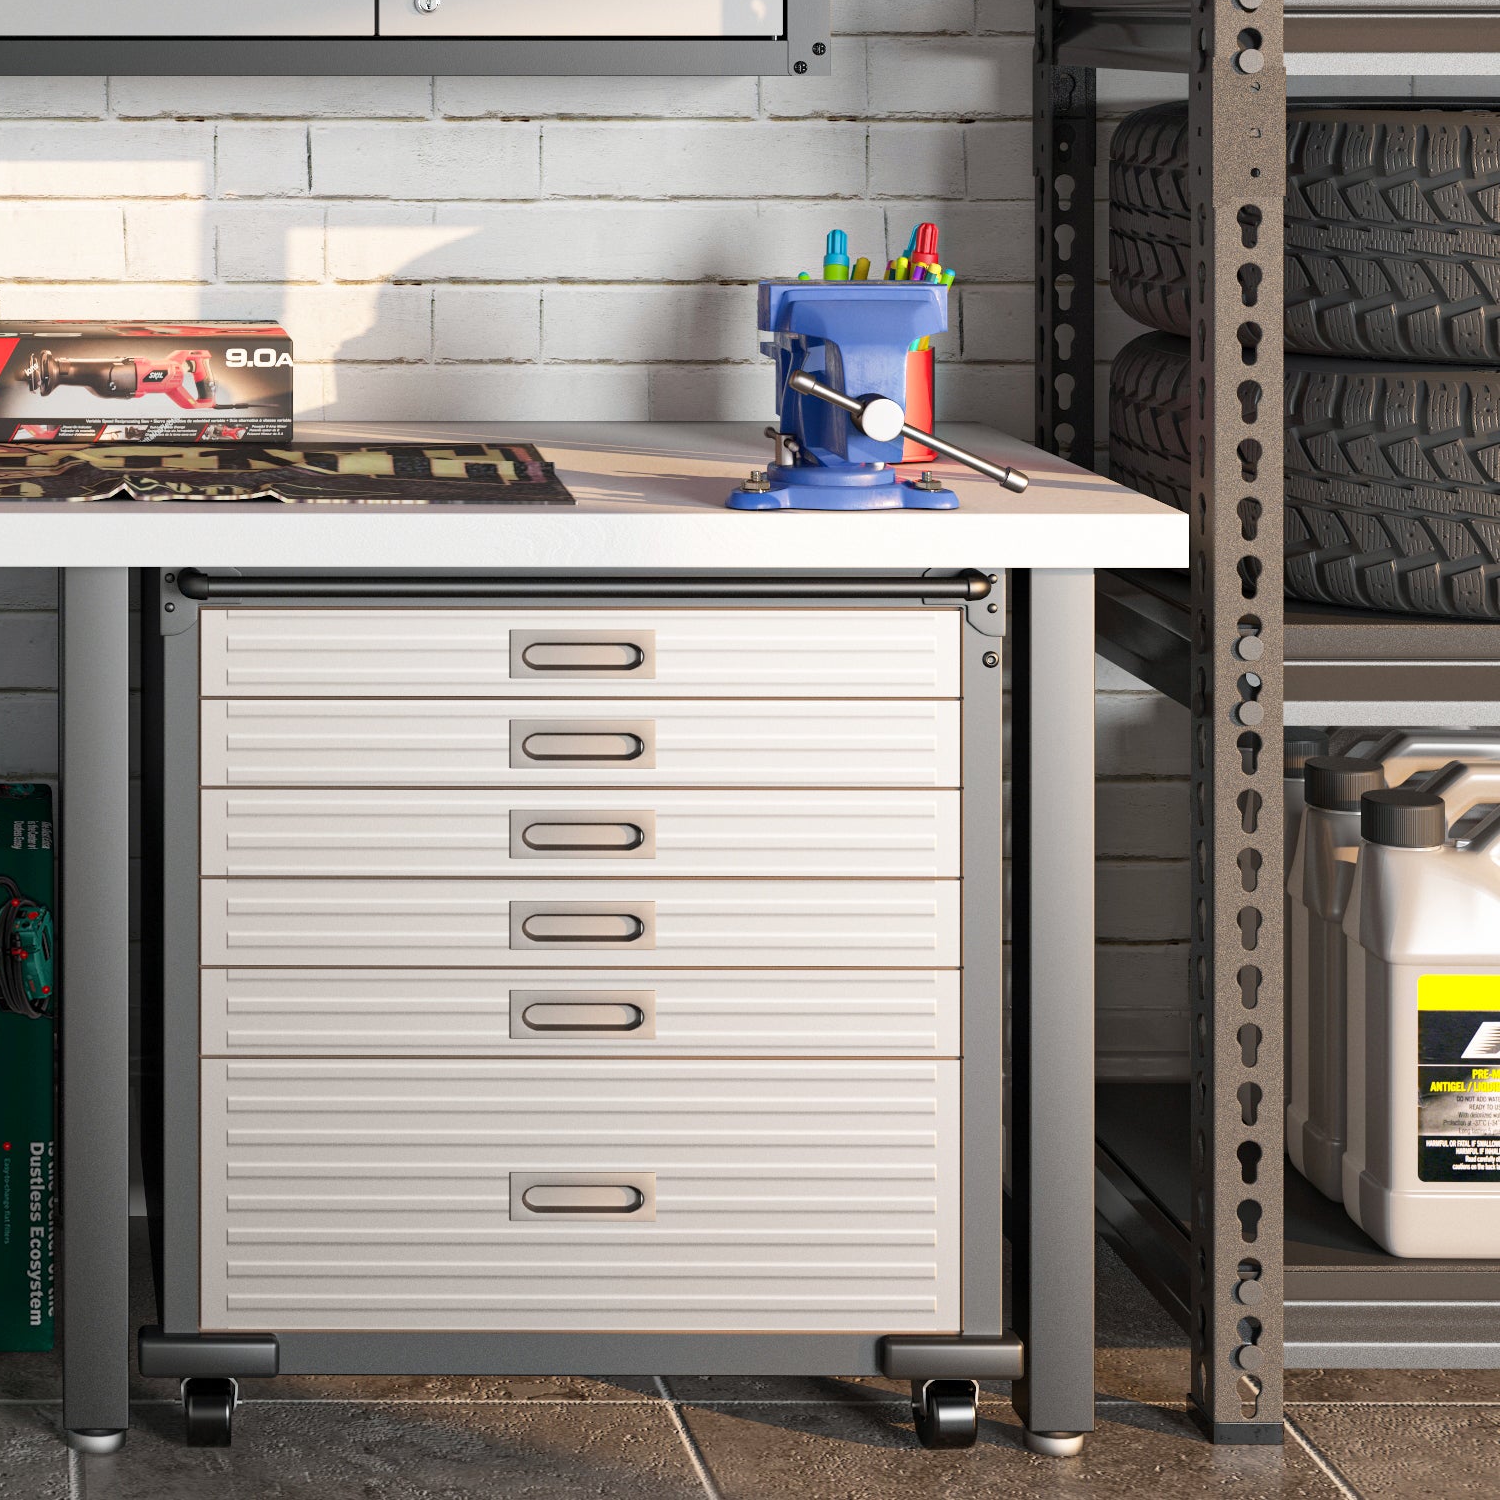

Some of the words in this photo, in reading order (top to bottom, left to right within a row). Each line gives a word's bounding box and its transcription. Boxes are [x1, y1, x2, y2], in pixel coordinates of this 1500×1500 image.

[148, 371, 164, 381] SKIL
[225, 347, 293, 368] 9.0A
[29, 1142, 45, 1222] Dustless
[26, 1227, 45, 1327] Ecosystem
